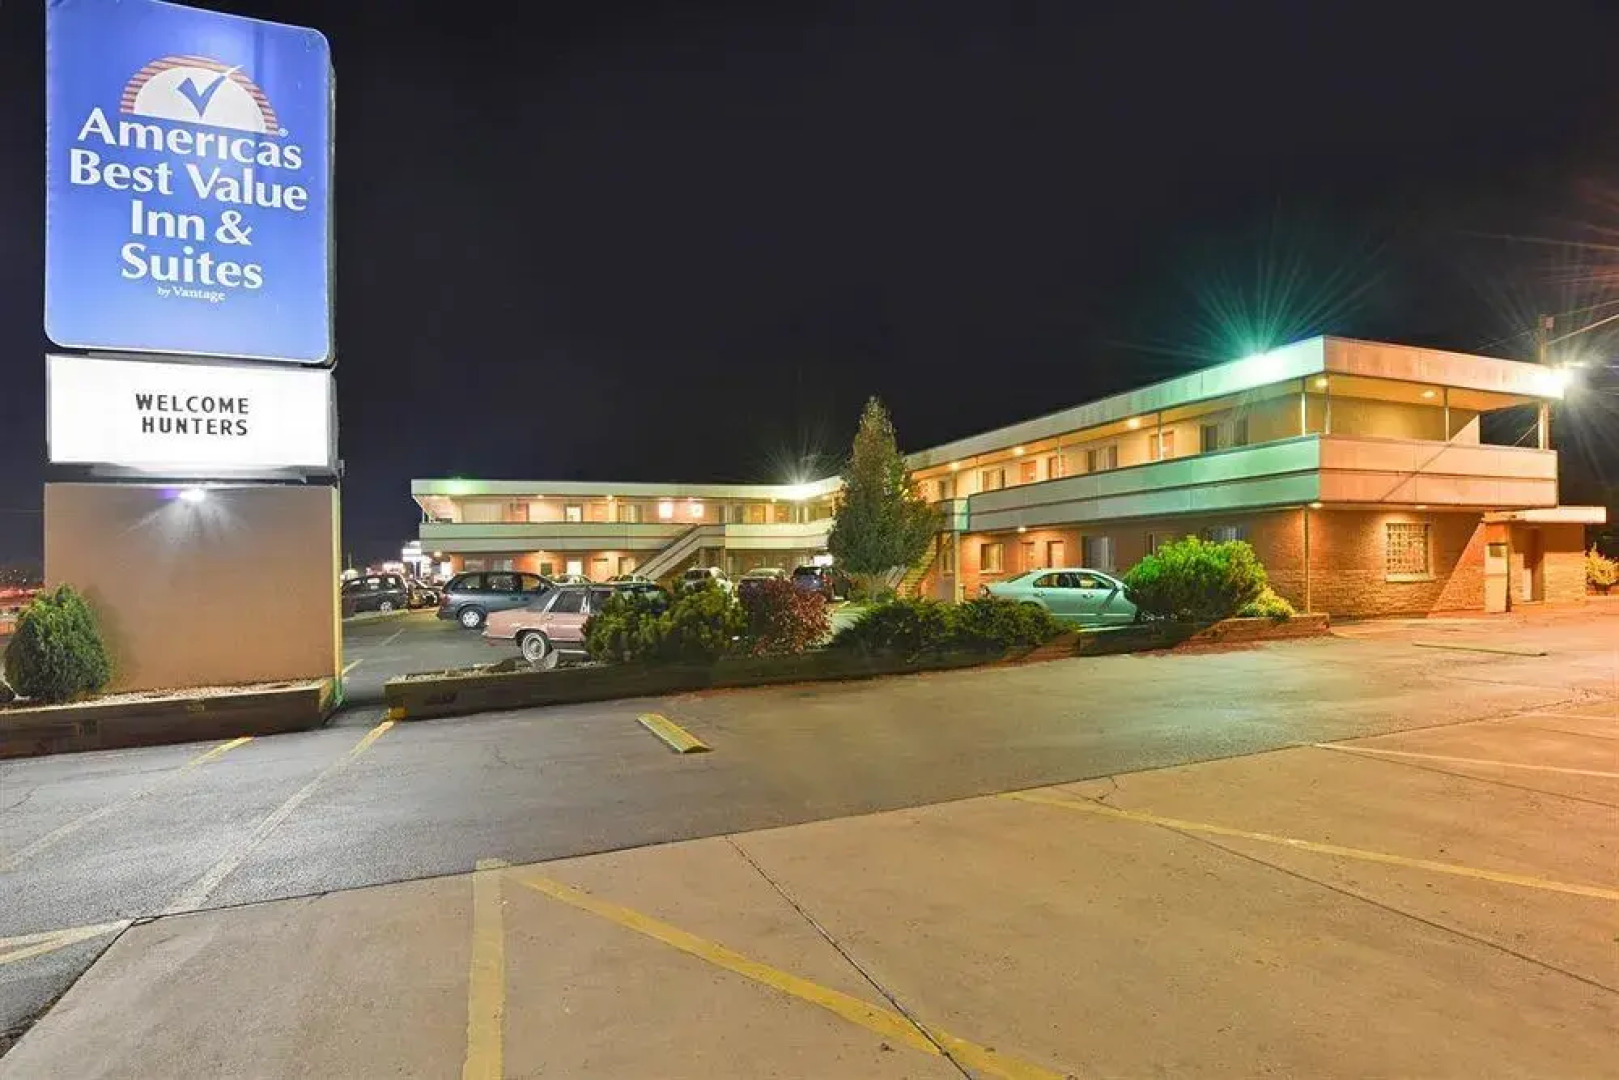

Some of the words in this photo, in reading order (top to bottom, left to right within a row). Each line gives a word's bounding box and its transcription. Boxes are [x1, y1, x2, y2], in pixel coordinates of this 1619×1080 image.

[77, 107, 302, 170] Americas
[70, 149, 173, 195] Best
[186, 163, 308, 211] Value
[130, 199, 205, 241] Inn
[215, 210, 252, 246] &
[120, 242, 263, 289] Suites
[157, 286, 171, 298] by
[172, 286, 225, 302] Vantage
[135, 392, 250, 414] WELCOME
[141, 416, 248, 436] HUNTERS
